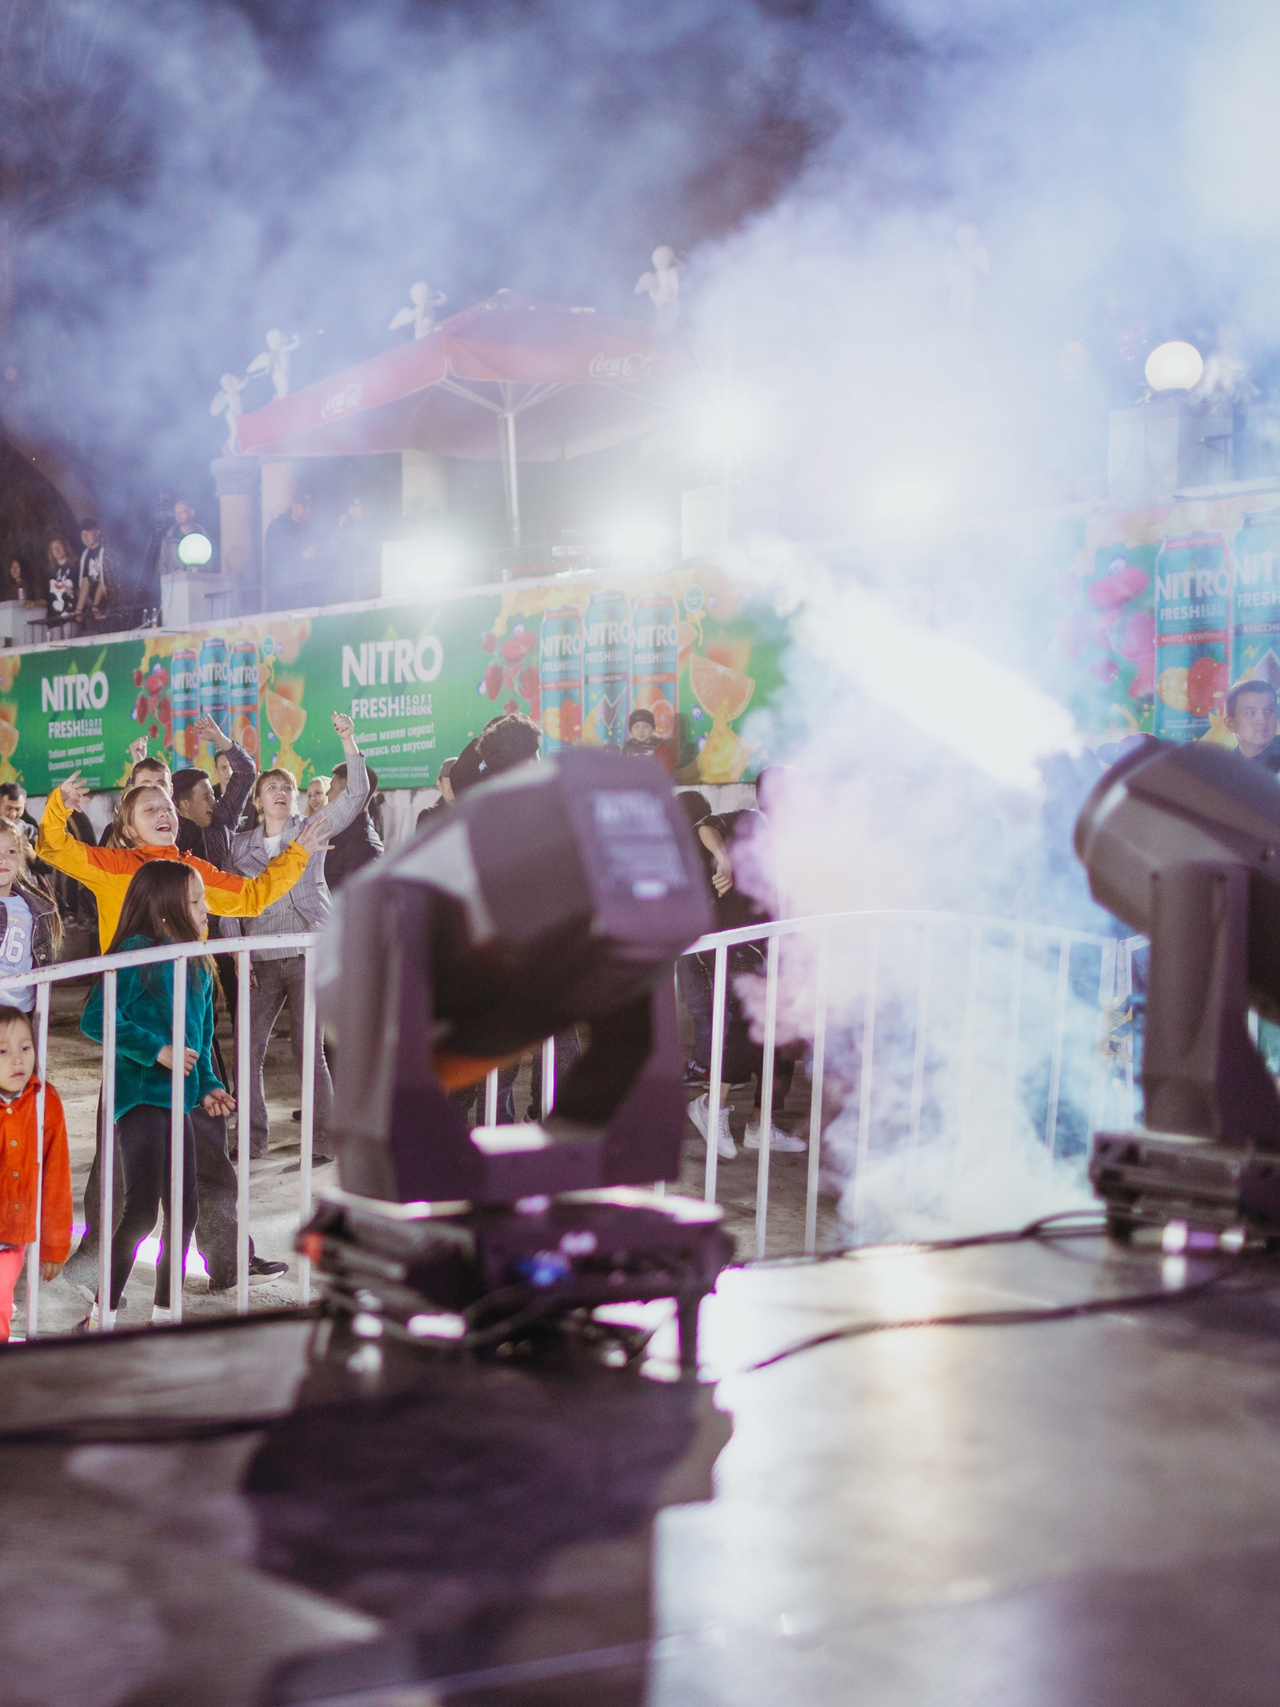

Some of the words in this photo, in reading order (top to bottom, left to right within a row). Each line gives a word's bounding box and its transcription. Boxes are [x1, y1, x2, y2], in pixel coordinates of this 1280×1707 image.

[1233, 551, 1280, 587] NIT
[1155, 569, 1230, 602] NITRO
[540, 634, 582, 658] NITRO
[582, 621, 631, 650] NITRO
[630, 624, 678, 651] NITRO
[199, 662, 228, 683] NITRO
[342, 635, 443, 688] NITRO
[229, 665, 259, 687] NITRO
[41, 671, 109, 712] NITRO
[406, 693, 433, 706] SOFT
[351, 694, 405, 719] FRESH!
[406, 704, 433, 717] DRINK
[48, 719, 85, 738] FRESH!
[379, 728, 406, 741] менен
[390, 744, 401, 754] со
[402, 736, 436, 754] вкусом!
